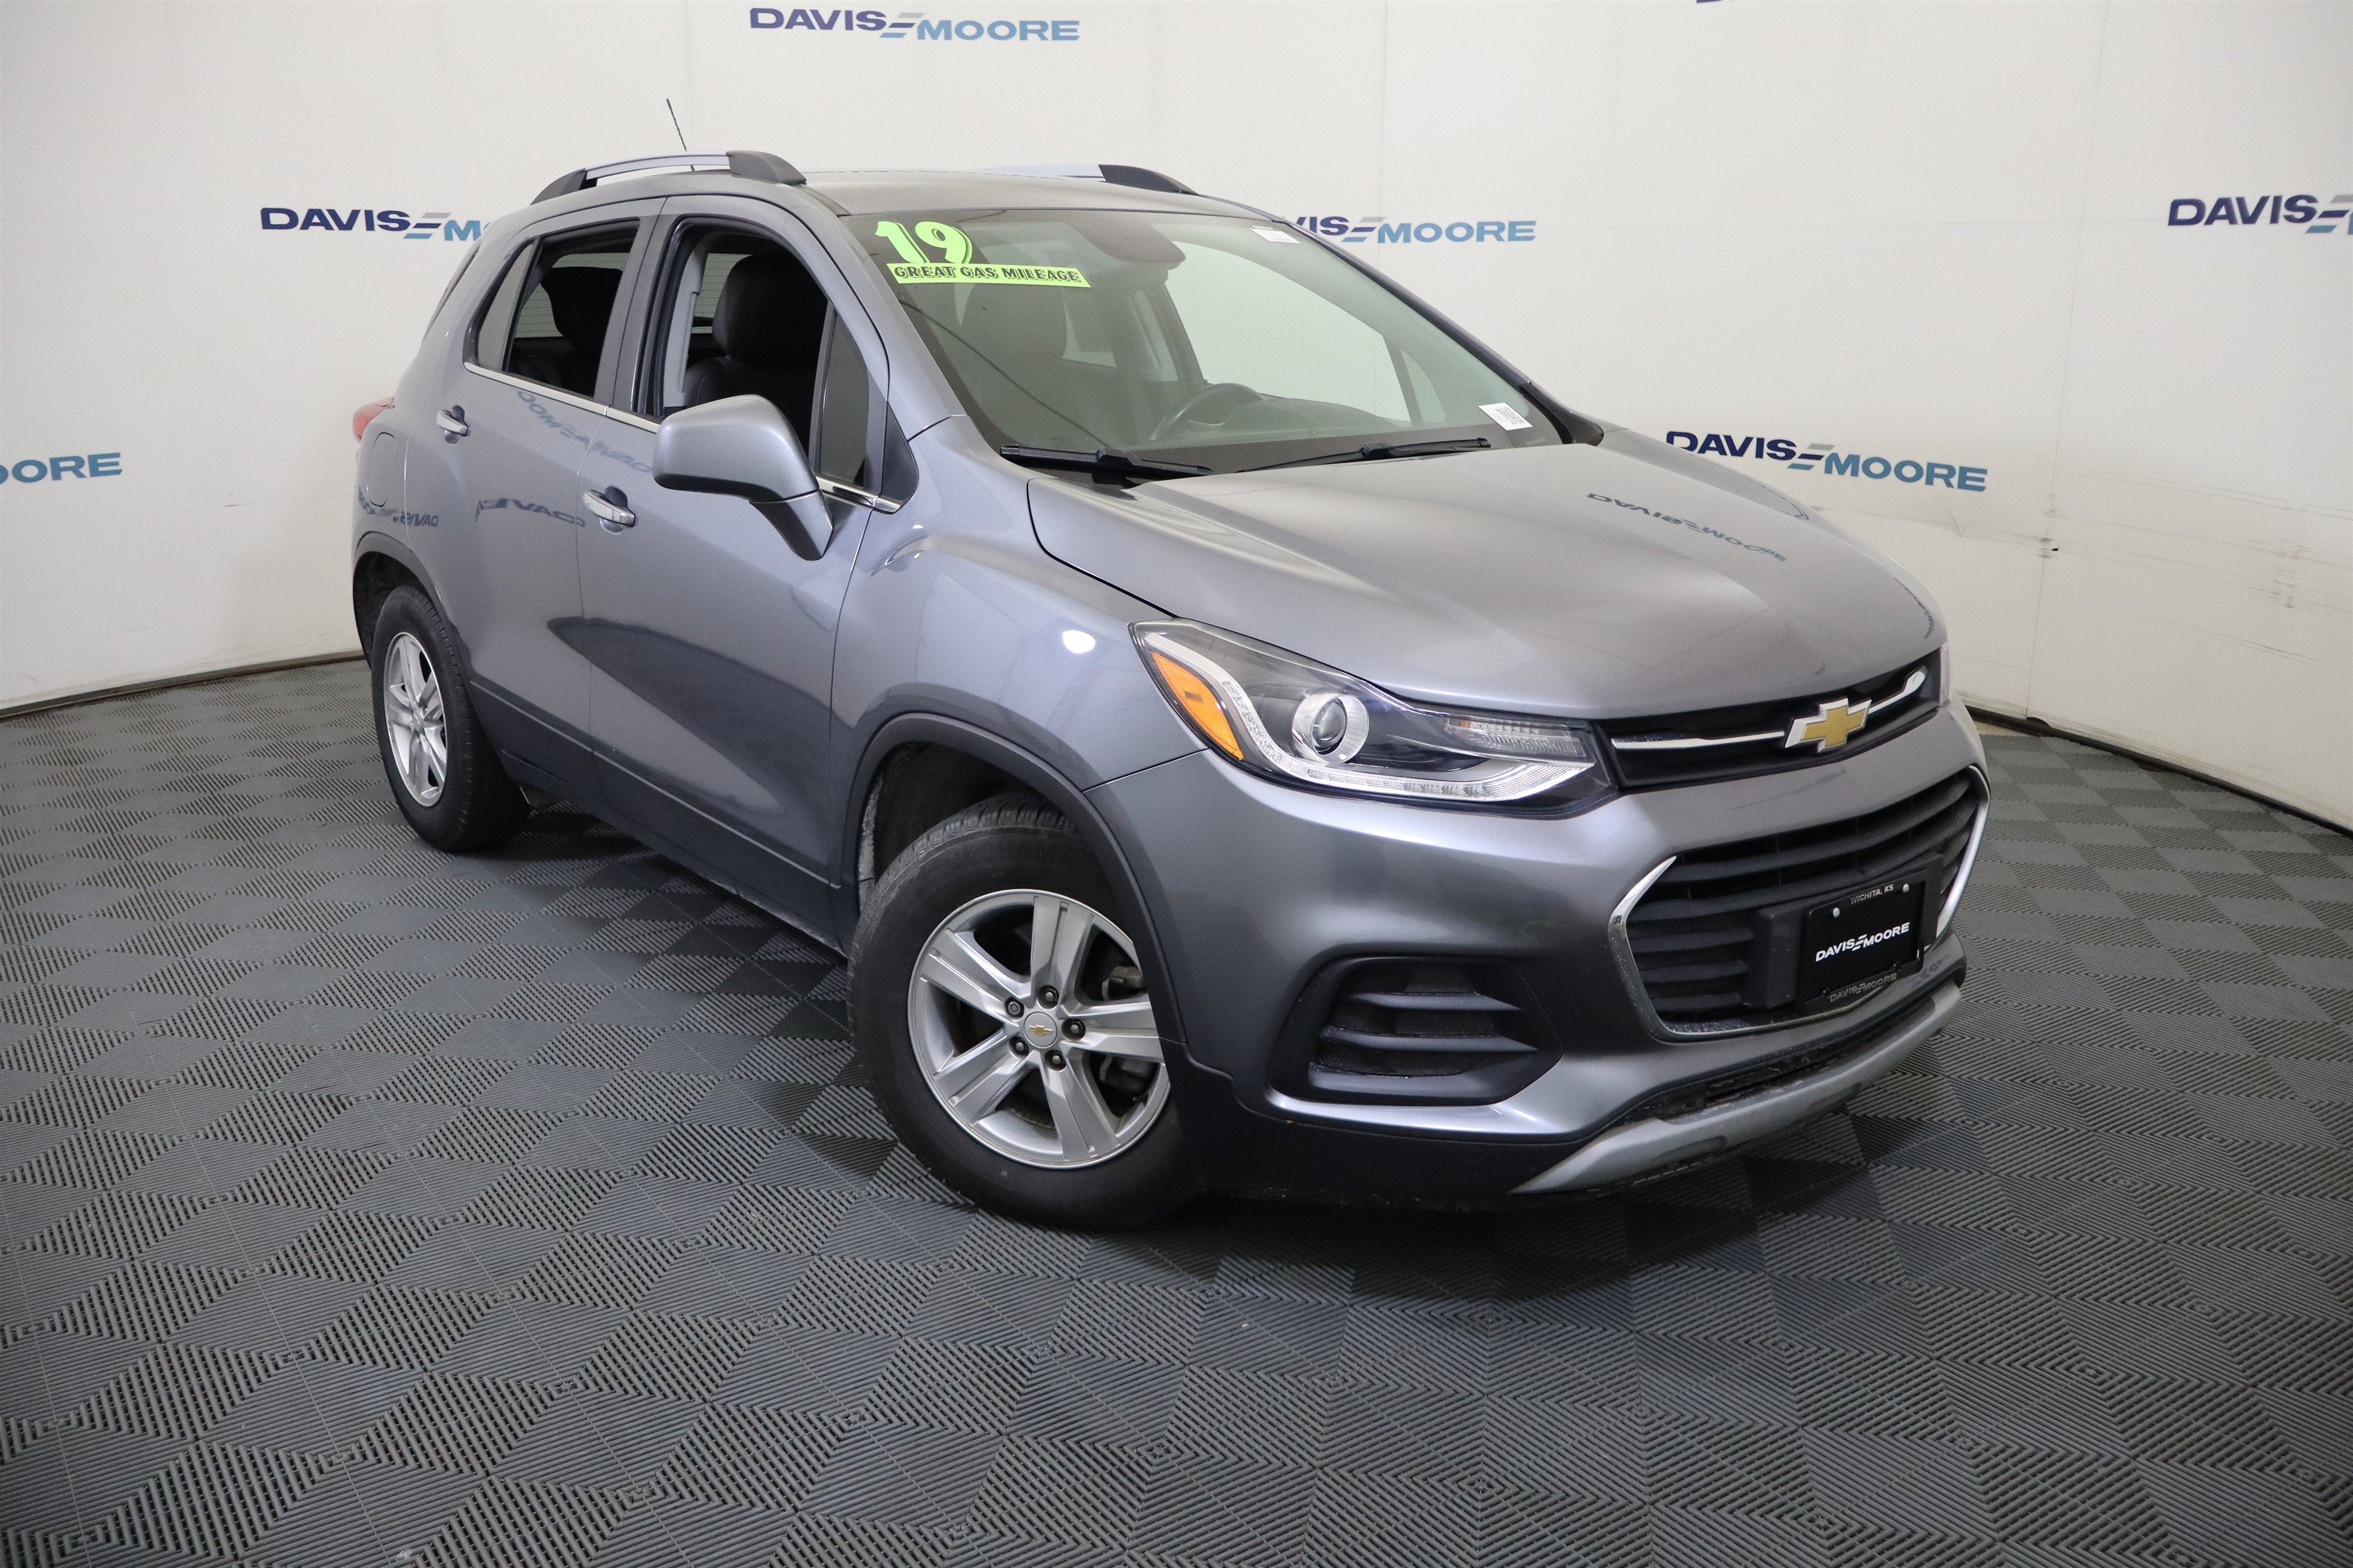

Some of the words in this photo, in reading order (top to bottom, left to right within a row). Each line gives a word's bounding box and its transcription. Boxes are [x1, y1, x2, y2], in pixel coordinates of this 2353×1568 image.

[750, 7, 886, 30] DAVIS
[917, 20, 1080, 41] MOORE
[261, 207, 410, 231] DAVIS
[2168, 194, 2318, 226] DAVIS
[875, 221, 973, 264] 19
[1378, 221, 1536, 244] MOORE
[894, 266, 955, 279] GREAT
[960, 266, 998, 279] GAS
[1002, 268, 1082, 283] MILEAGE
[0, 452, 122, 484] ORE
[1667, 431, 1796, 460] DAVIS
[1824, 453, 1987, 492] MOORE
[1884, 884, 1894, 893] KS
[1815, 939, 1856, 962] DAVIS
[1863, 922, 1910, 948] MOORE
[1829, 986, 1858, 1002] DAVIS
[1862, 973, 1897, 992] MOORE
